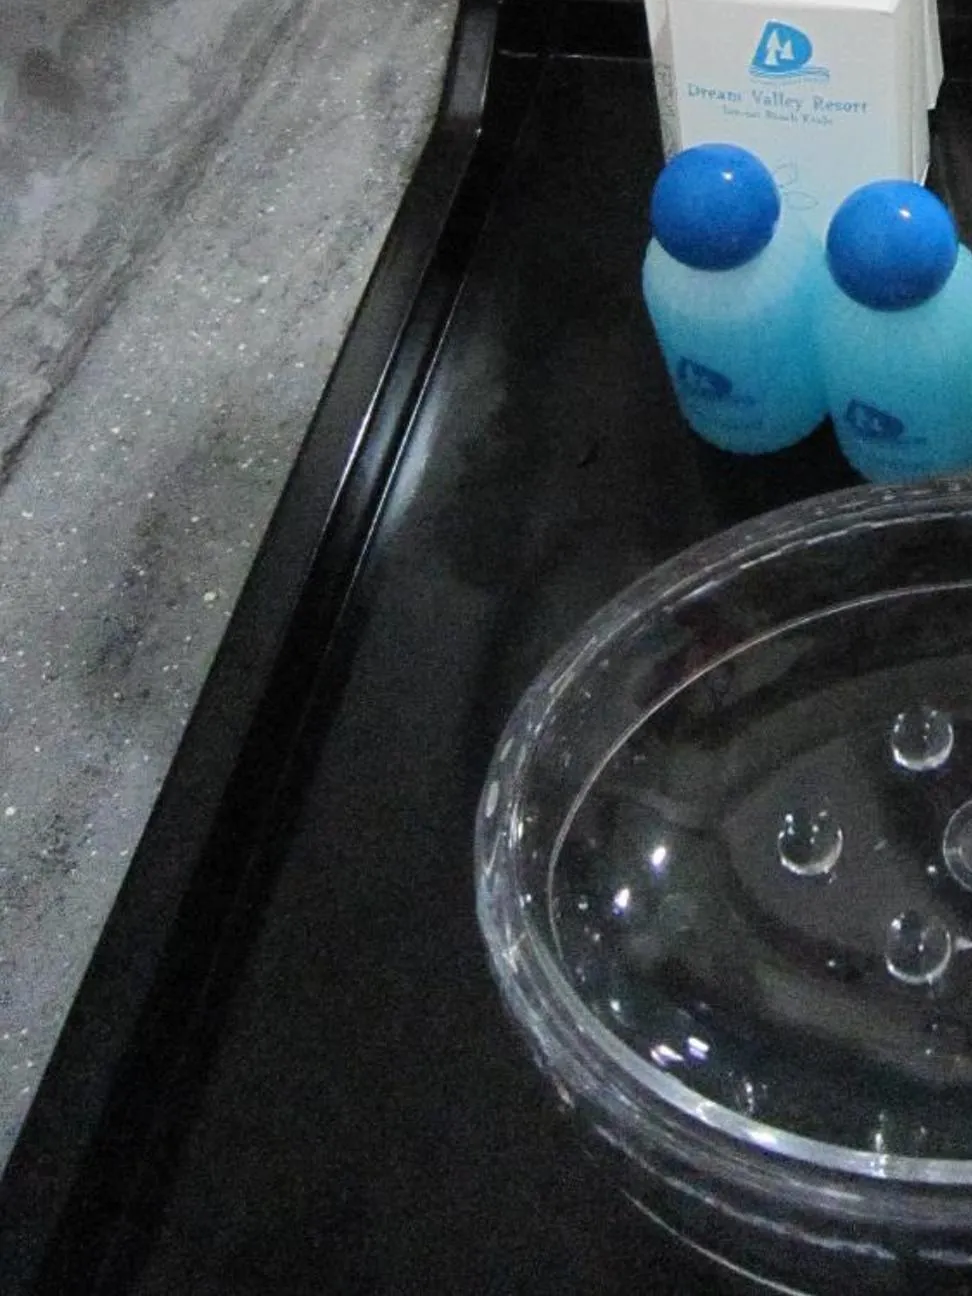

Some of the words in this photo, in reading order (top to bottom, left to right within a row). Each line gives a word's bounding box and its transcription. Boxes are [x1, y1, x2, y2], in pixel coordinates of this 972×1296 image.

[688, 82, 742, 102] Dream
[751, 89, 803, 111] Valley
[813, 95, 867, 113] Resort
